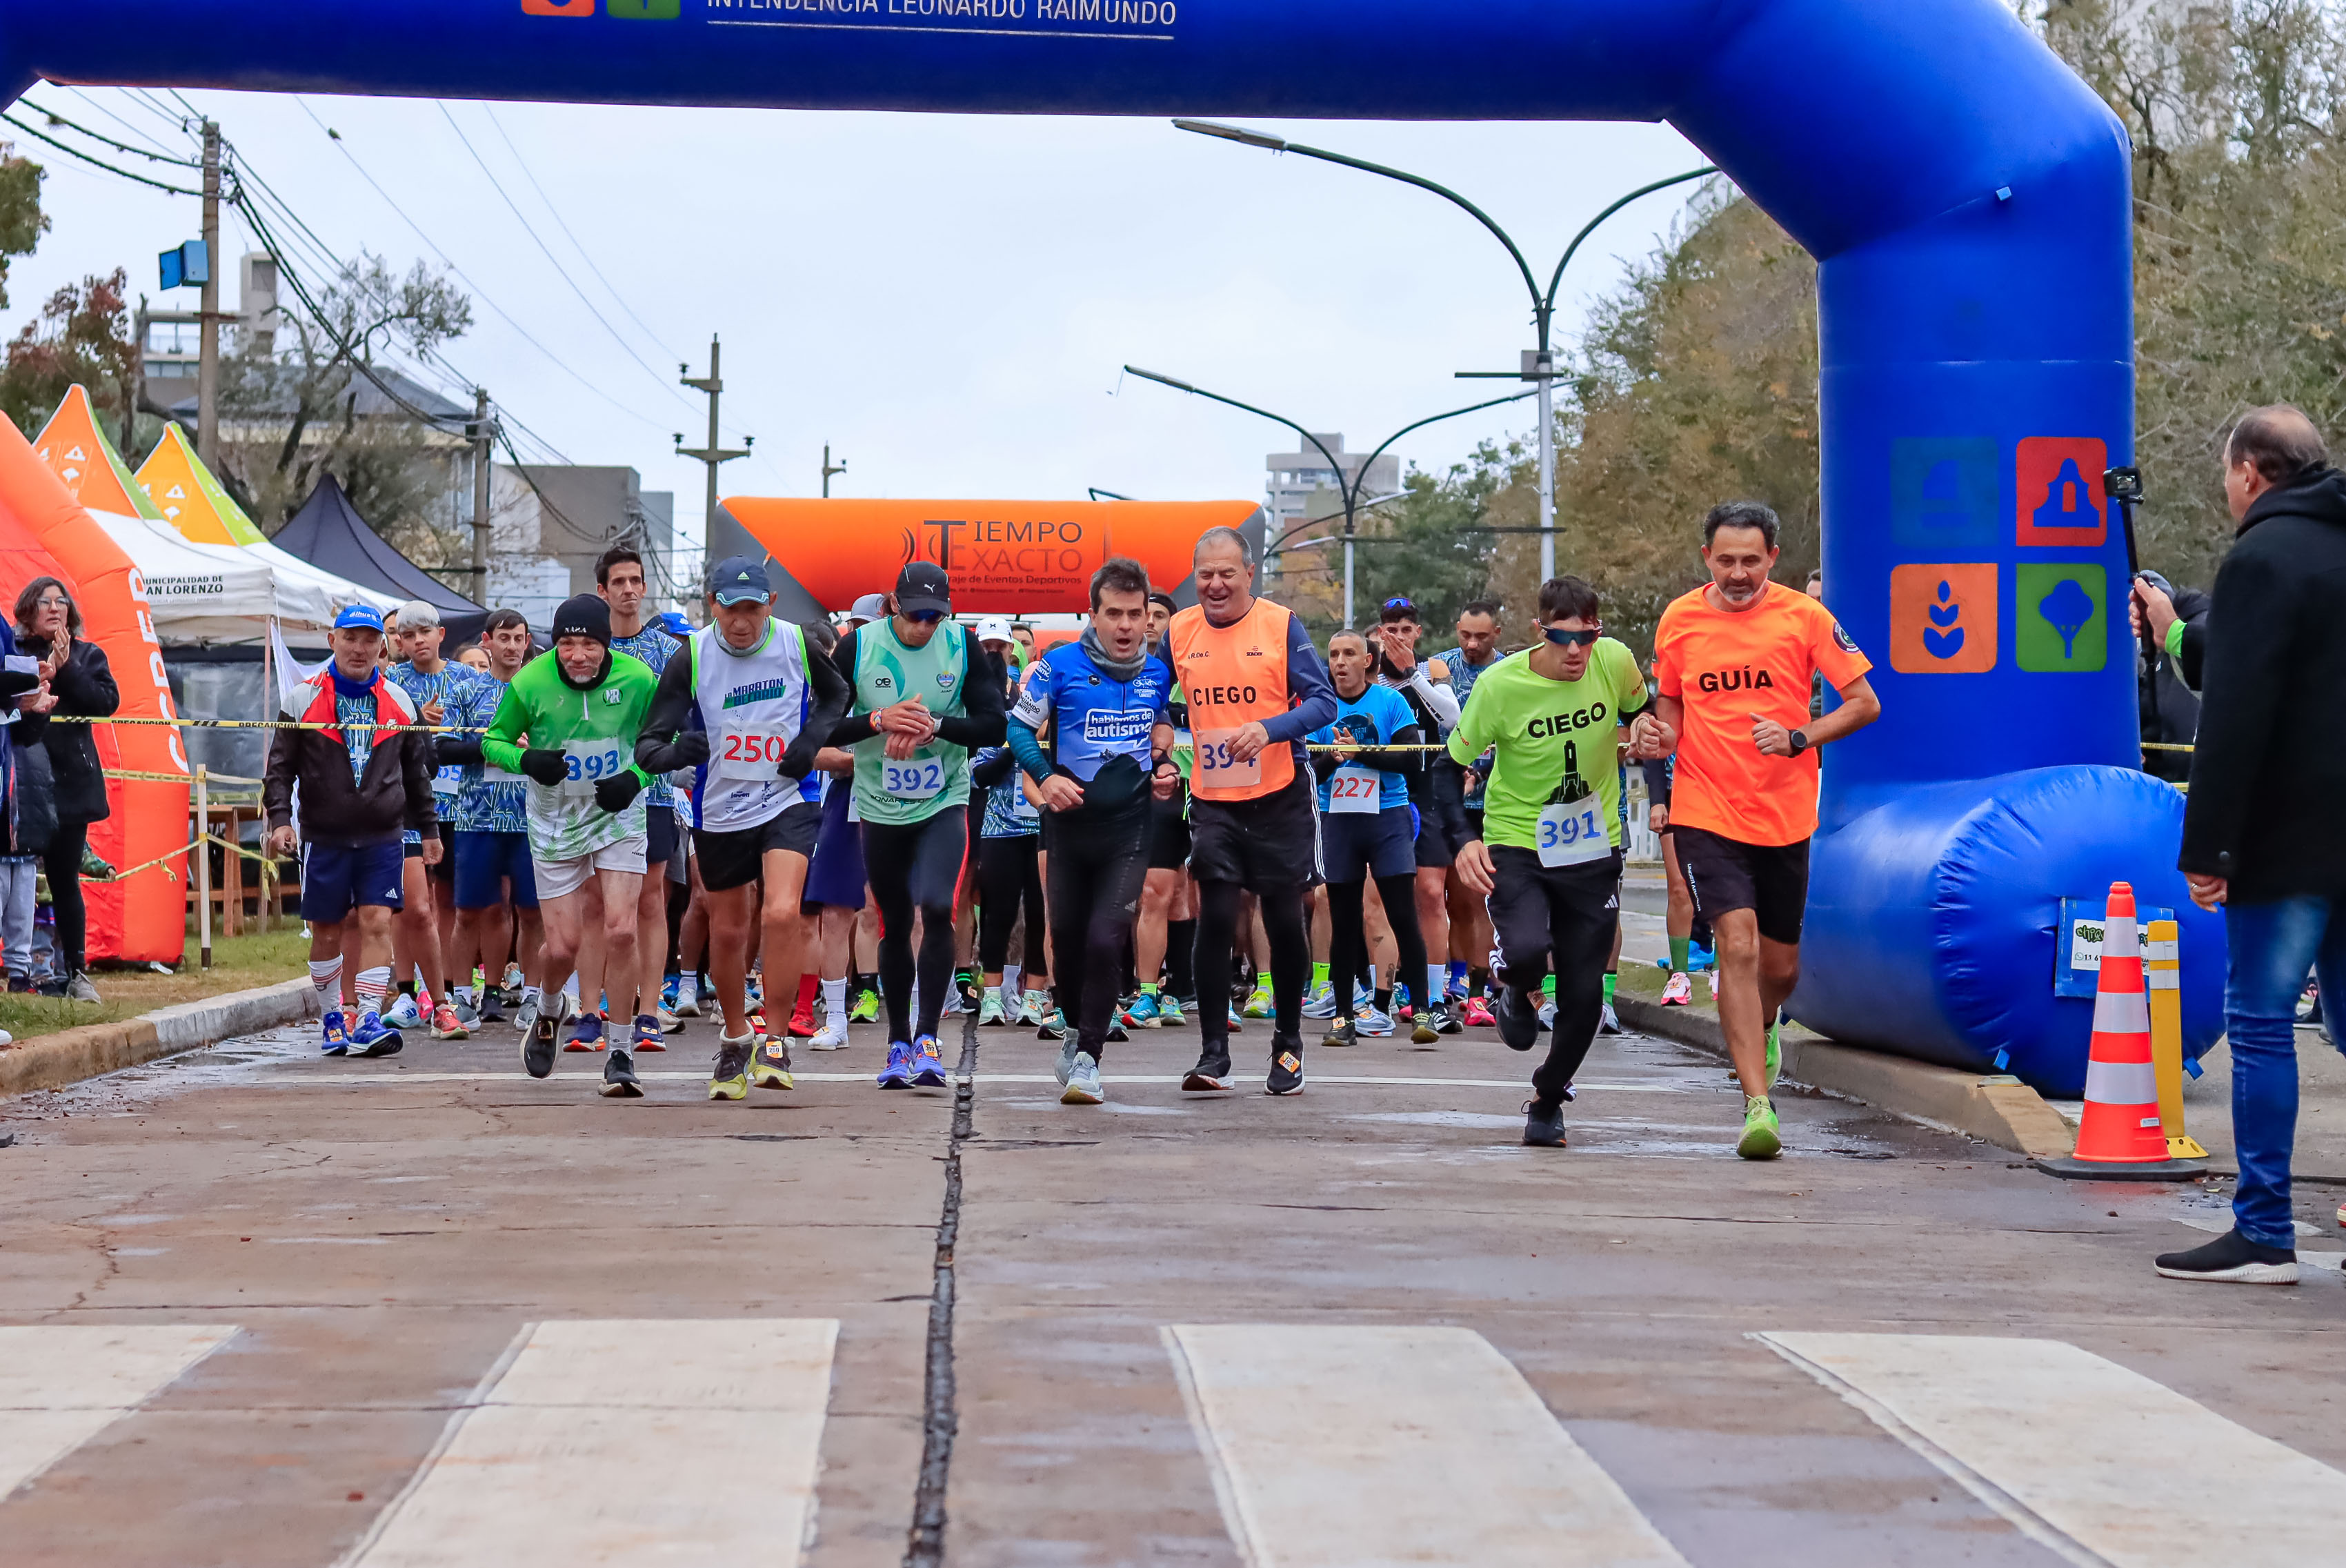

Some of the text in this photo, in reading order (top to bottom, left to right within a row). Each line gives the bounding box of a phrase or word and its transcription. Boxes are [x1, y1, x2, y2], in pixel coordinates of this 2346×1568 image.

[1037, 0, 1176, 25] RAIMUNDO
[146, 584, 223, 595] AN LORENZO
[969, 575, 982, 584] de
[984, 575, 1023, 584] Eventos
[1026, 575, 1082, 585] Deportivos
[1699, 665, 1773, 693] GUÍA
[1193, 686, 1256, 706] CIEGO
[1091, 711, 1152, 724] hablemos de
[1528, 702, 1607, 739] CIEGO
[724, 735, 786, 763] 250
[565, 750, 619, 781] 393
[887, 764, 940, 791] 392
[1332, 777, 1376, 799] 227
[1542, 810, 1601, 848] 391
